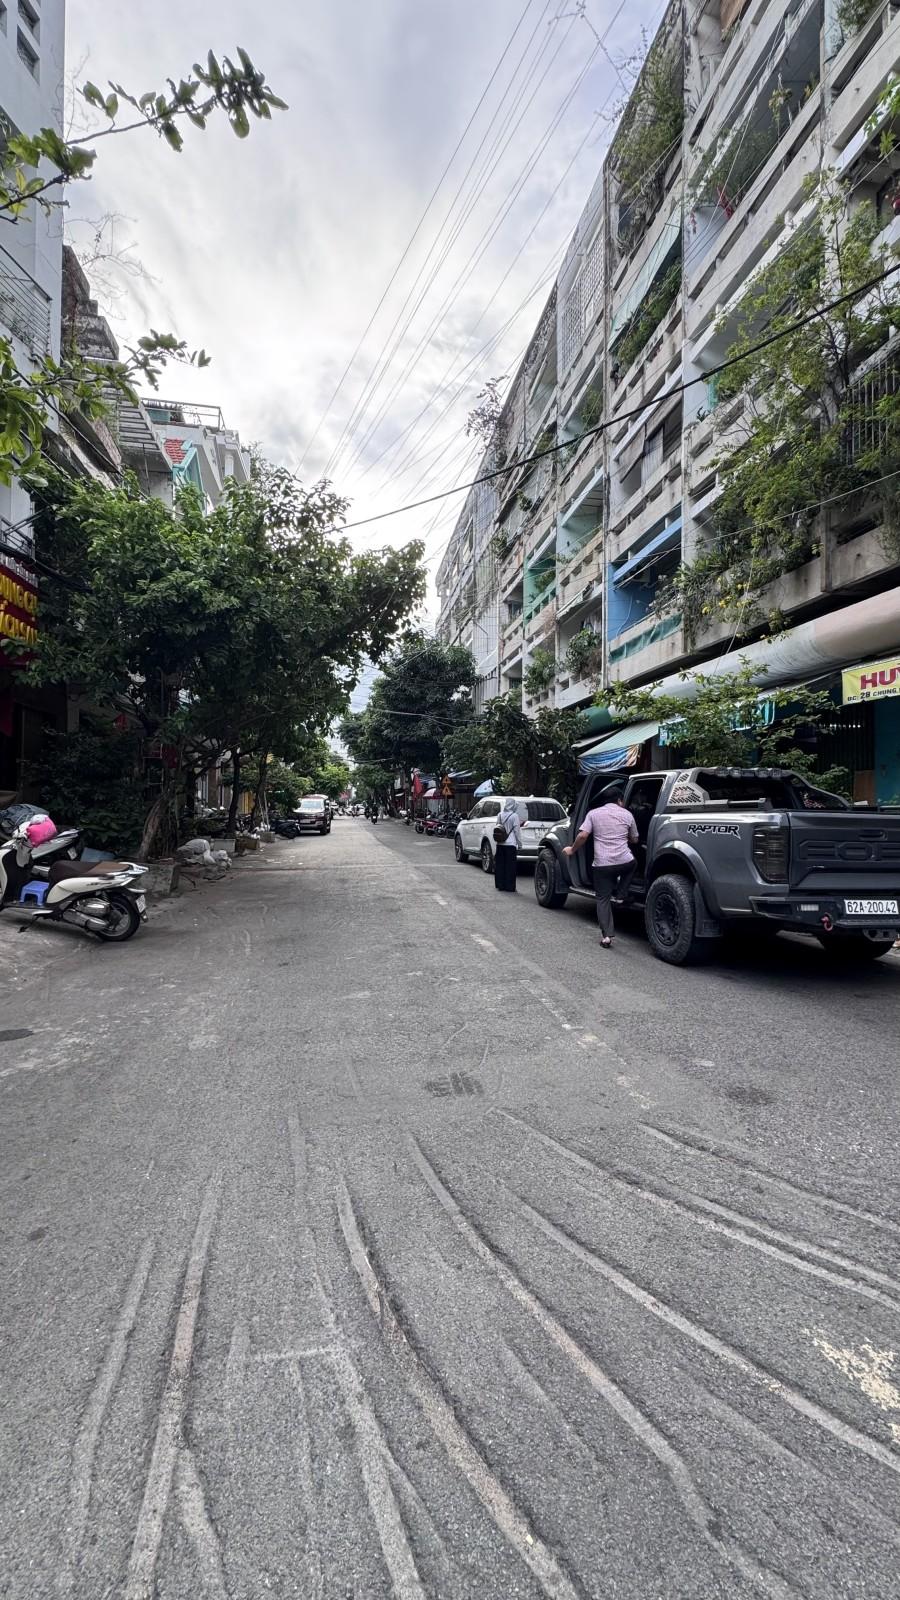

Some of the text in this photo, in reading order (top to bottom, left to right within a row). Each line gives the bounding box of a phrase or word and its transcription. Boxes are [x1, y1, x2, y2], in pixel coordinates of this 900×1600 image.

[861, 664, 900, 690] HU
[873, 688, 896, 697] CHUNG
[687, 823, 741, 840] RAPTOR
